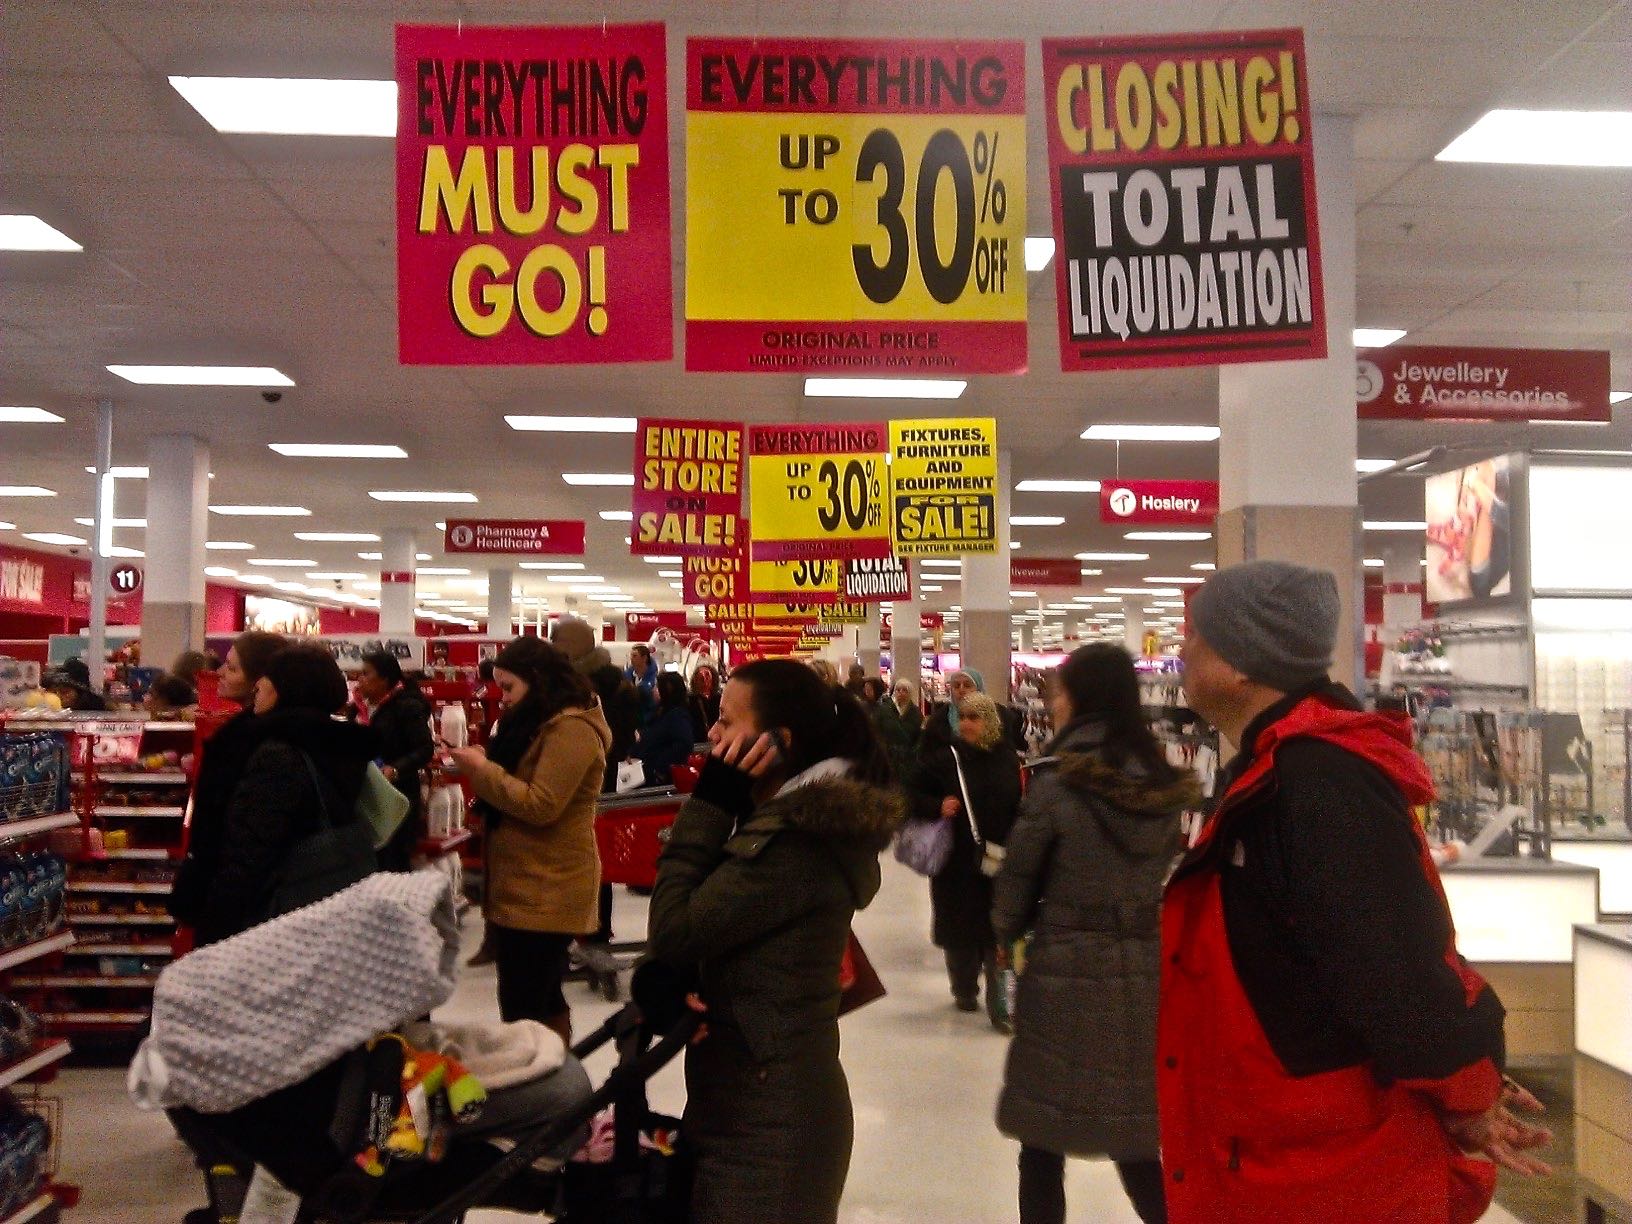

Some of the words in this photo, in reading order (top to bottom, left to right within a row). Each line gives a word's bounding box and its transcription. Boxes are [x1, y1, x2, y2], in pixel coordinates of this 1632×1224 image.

[701, 55, 1008, 106] EVERYTHING
[417, 57, 648, 137] EVERYTHING
[1056, 50, 1301, 153] CLOSING!
[779, 133, 841, 170] UP
[417, 143, 639, 235] MUST
[778, 188, 839, 225] TO
[1083, 164, 1288, 248] TOTAL
[976, 236, 1008, 294] OFF
[450, 243, 608, 338] GO!
[1069, 247, 1312, 341] LIQUIDATION
[762, 331, 872, 349] ORIGINAL
[880, 331, 939, 349] PRICE
[749, 354, 798, 366] LIMITED
[801, 354, 880, 366] EXCEPTIONS
[886, 354, 913, 367] MAY
[1394, 361, 1508, 387] Jewellery
[1394, 384, 1411, 404] &
[1420, 384, 1569, 407] Accessories
[645, 427, 740, 461] ENTIRE
[755, 430, 879, 452] EVERYTHING
[901, 428, 985, 442] FIXTURES,
[896, 444, 990, 458] FURNITURE
[643, 460, 738, 493] STORE
[787, 463, 812, 478] UP
[926, 460, 963, 473] AND
[787, 485, 812, 500] TO
[895, 477, 994, 490] EQUIPMENT
[665, 496, 706, 511] ON
[910, 495, 979, 506] FOR
[1141, 495, 1200, 513] Hosiery
[868, 503, 881, 527] OFF
[901, 505, 989, 540] SALE!
[476, 525, 538, 539] Pharmacy
[540, 525, 550, 538] &
[638, 512, 736, 546] SALE!
[476, 537, 542, 549] Healthcare
[897, 544, 913, 553] SEE
[916, 544, 950, 553] FIXTURE
[953, 543, 995, 552] MANAGER
[116, 570, 134, 588] 11
[694, 574, 735, 599] GO!
[846, 571, 908, 597] LIQUIDATION
